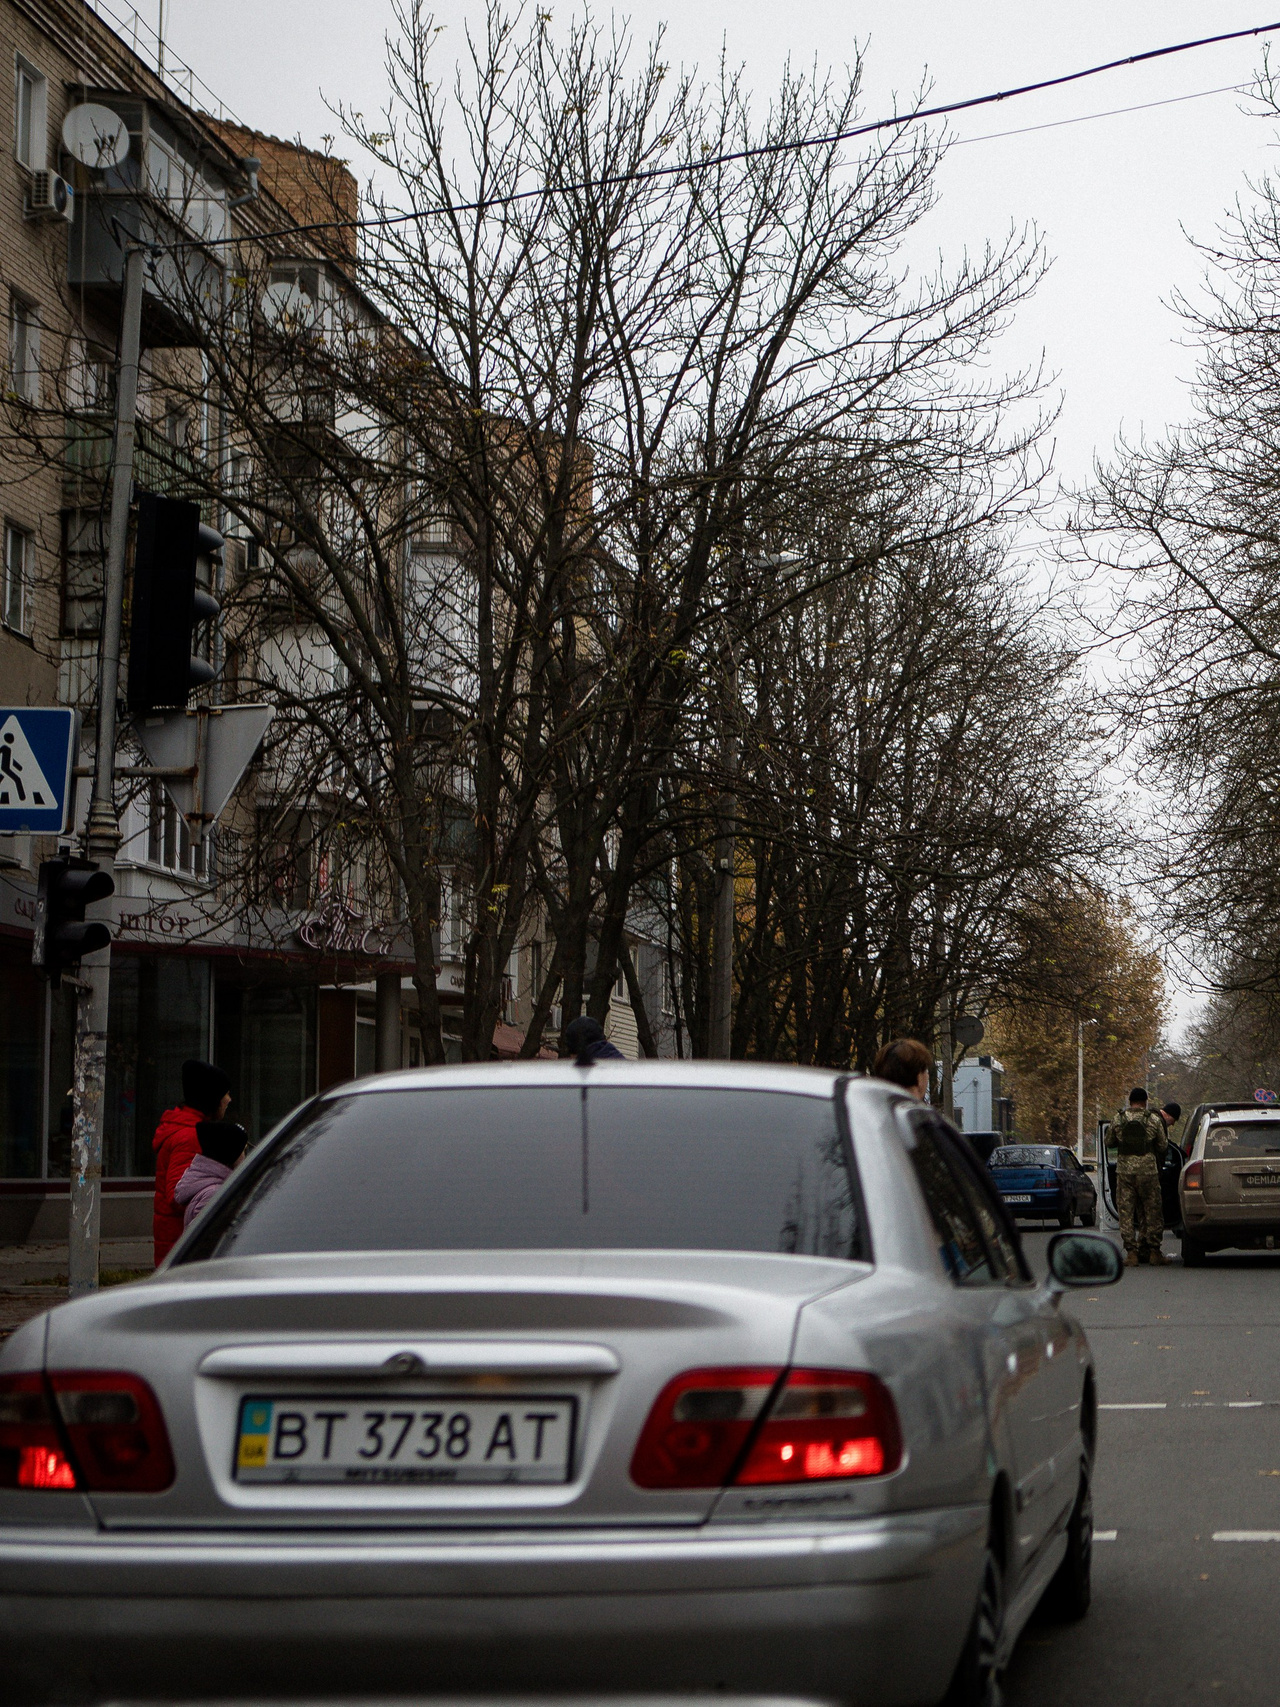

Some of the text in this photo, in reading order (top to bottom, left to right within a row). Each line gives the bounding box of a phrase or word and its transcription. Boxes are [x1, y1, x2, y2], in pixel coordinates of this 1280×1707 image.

[243, 1445, 265, 1458] UA
[273, 1412, 559, 1461] BT 3738 AT
